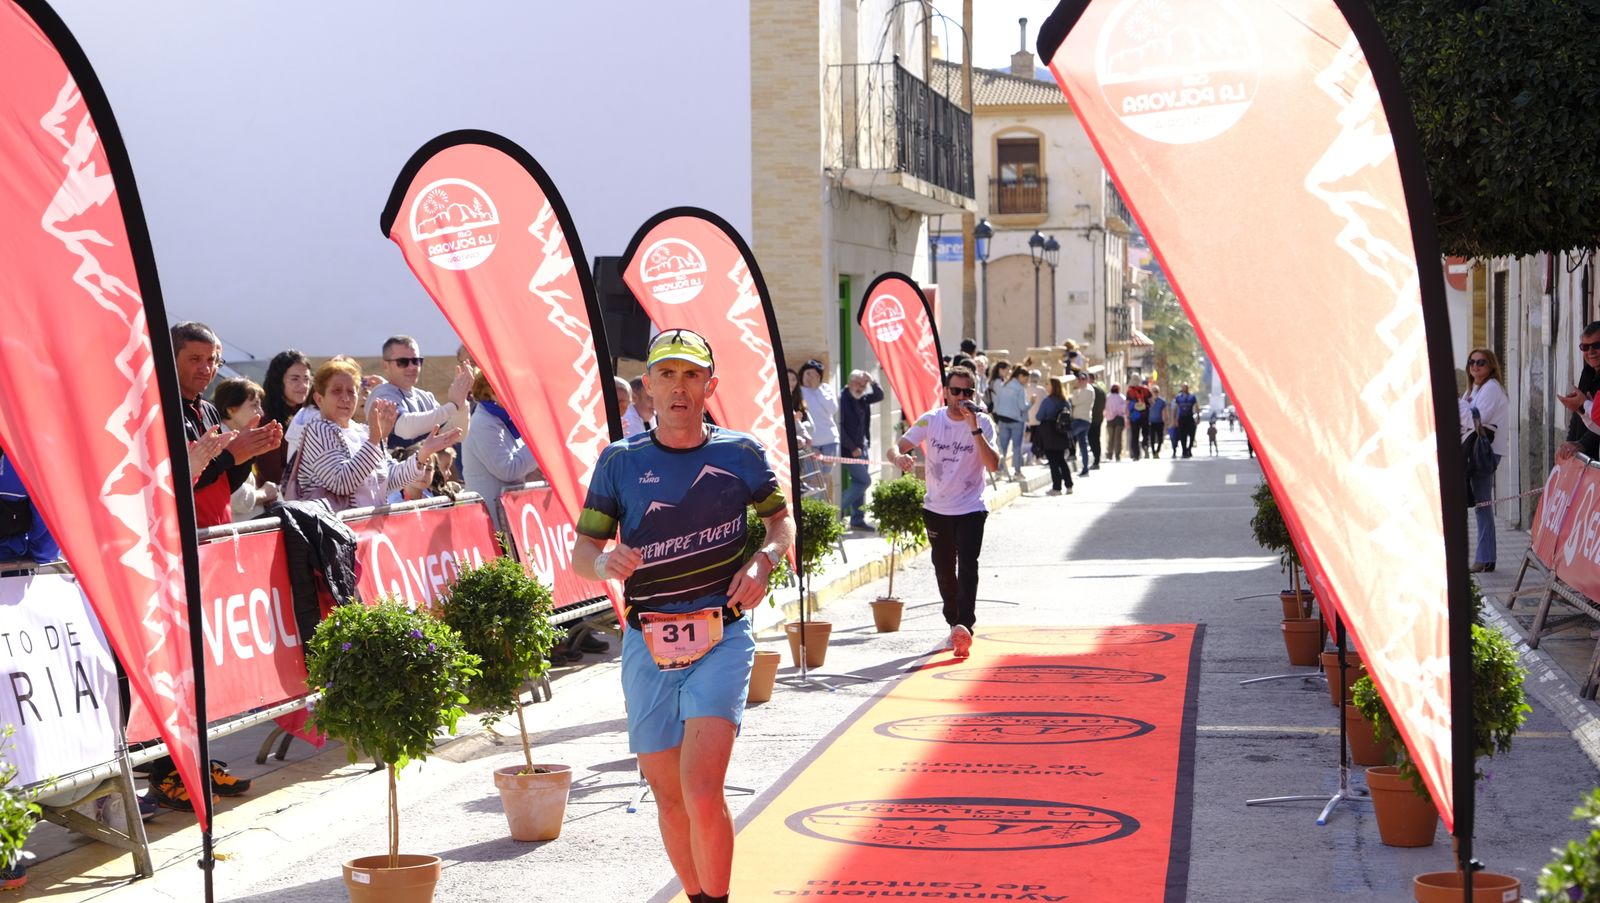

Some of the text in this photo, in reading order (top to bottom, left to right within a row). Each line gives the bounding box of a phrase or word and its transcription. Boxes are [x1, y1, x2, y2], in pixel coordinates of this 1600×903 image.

[640, 514, 742, 560] SIEMPRE FUERTE
[44, 622, 81, 651] DE
[662, 623, 696, 643] 31
[878, 767, 1104, 777] Ayuntamiento
[842, 806, 1031, 815] POLVORA
[805, 880, 1047, 892] de Cantoria
[773, 889, 1069, 902] Ayuntamiento
